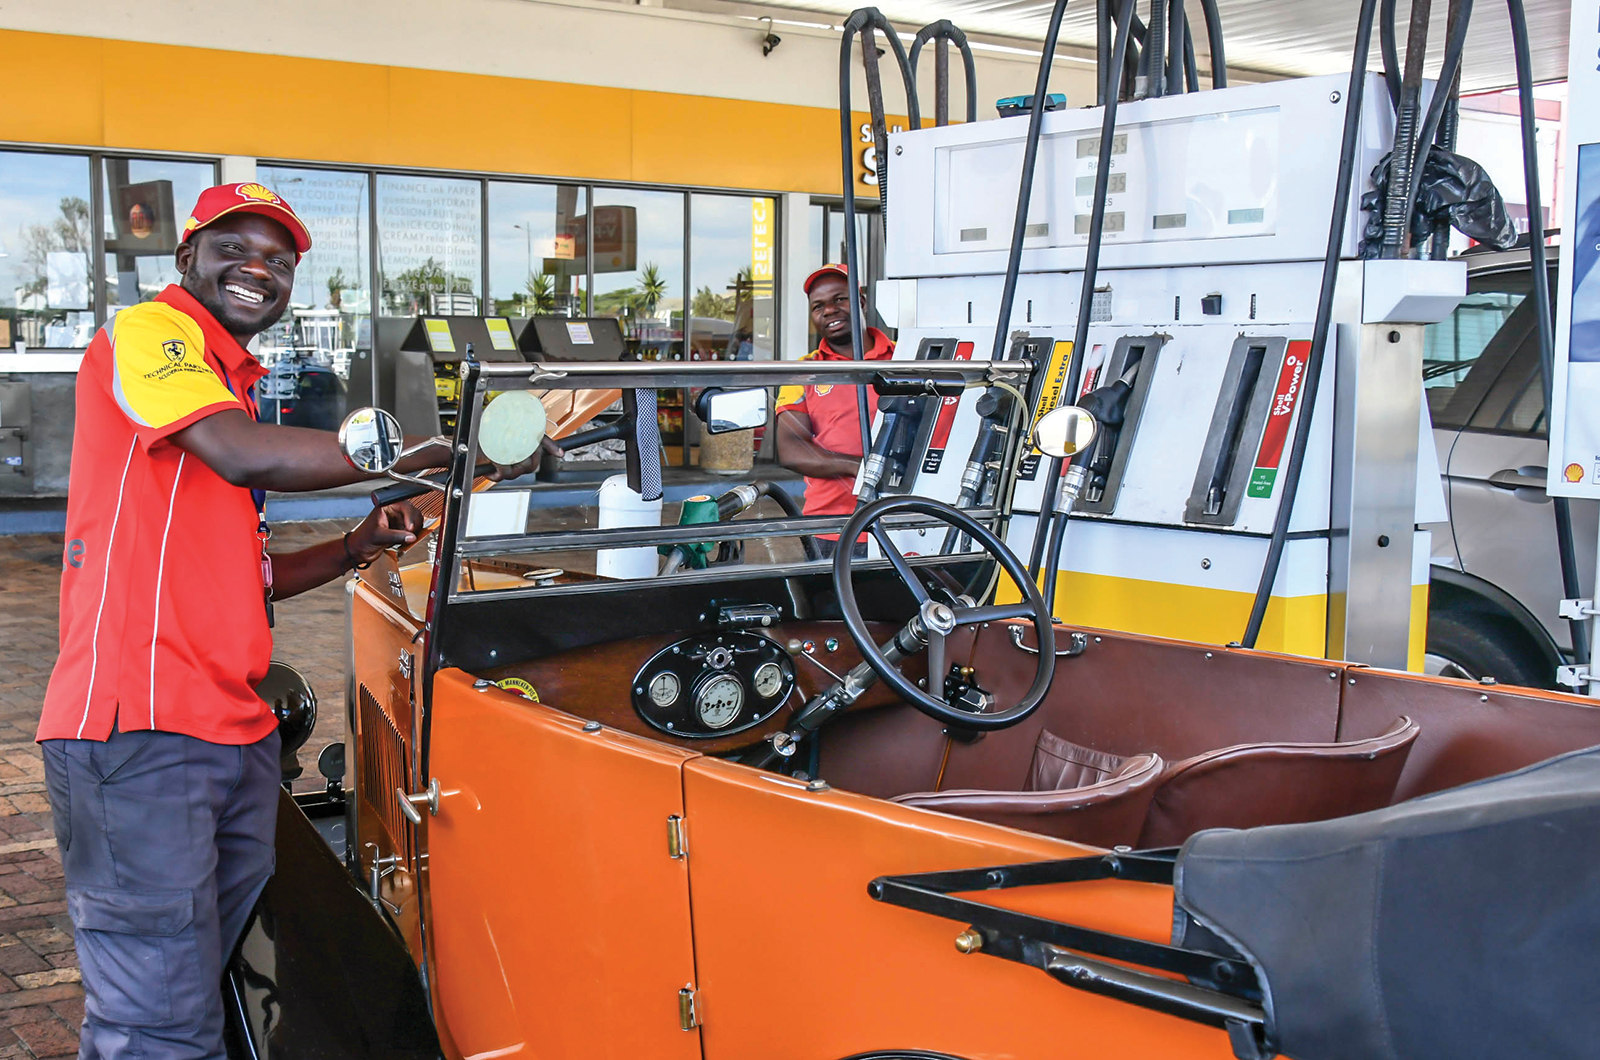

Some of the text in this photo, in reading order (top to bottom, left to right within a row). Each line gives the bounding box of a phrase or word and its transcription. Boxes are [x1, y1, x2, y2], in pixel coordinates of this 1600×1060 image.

[1088, 159, 1115, 170] RAS
[307, 190, 335, 200] COLD
[382, 181, 427, 192] FINANCE
[448, 186, 476, 195] PAPER
[424, 221, 451, 231] COLD
[383, 231, 424, 241] CREAMY
[452, 234, 476, 243] OATS
[143, 362, 183, 379] TECHNICAL
[1055, 354, 1069, 383] Extra
[1280, 360, 1304, 416] V-Power
[1037, 396, 1048, 418] Shell
[1046, 386, 1060, 411] iesel
[1273, 394, 1285, 416] Shell
